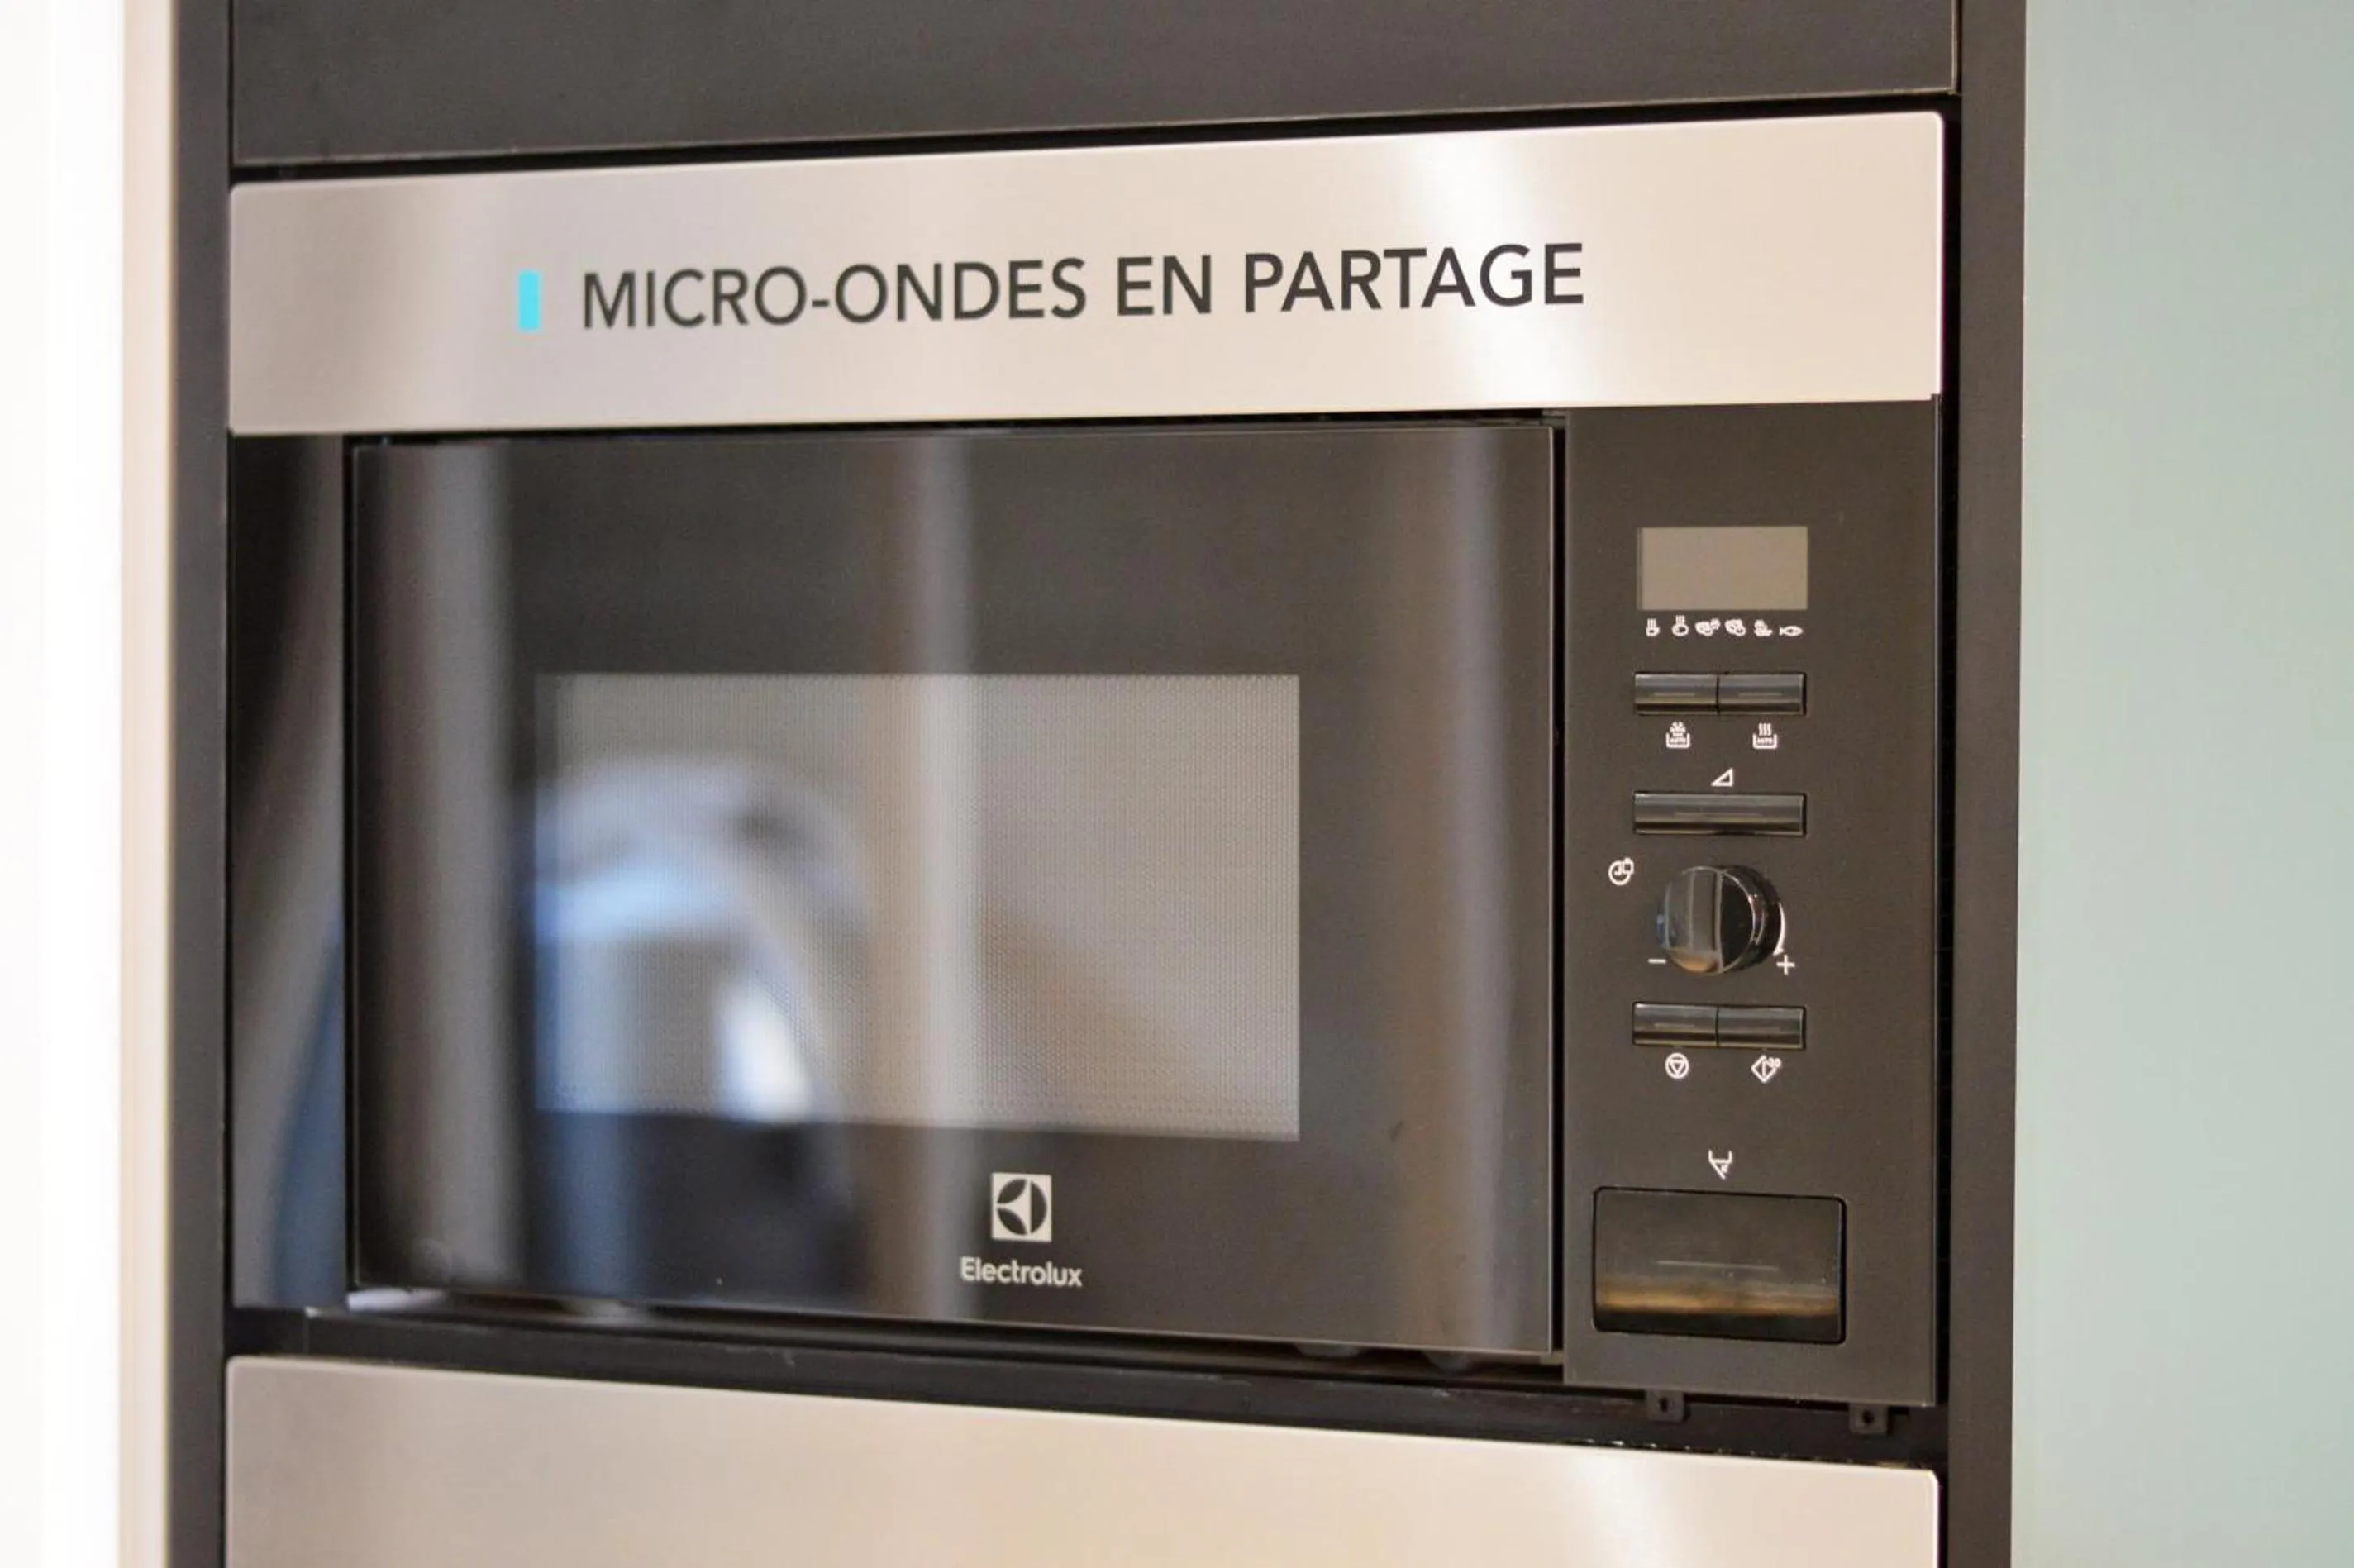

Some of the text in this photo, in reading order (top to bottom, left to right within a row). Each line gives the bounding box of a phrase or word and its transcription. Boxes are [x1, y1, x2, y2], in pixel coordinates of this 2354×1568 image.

[584, 243, 1584, 328] MICRO-ONDES EN PARTAGE
[960, 1256, 1083, 1287] Electrolux
